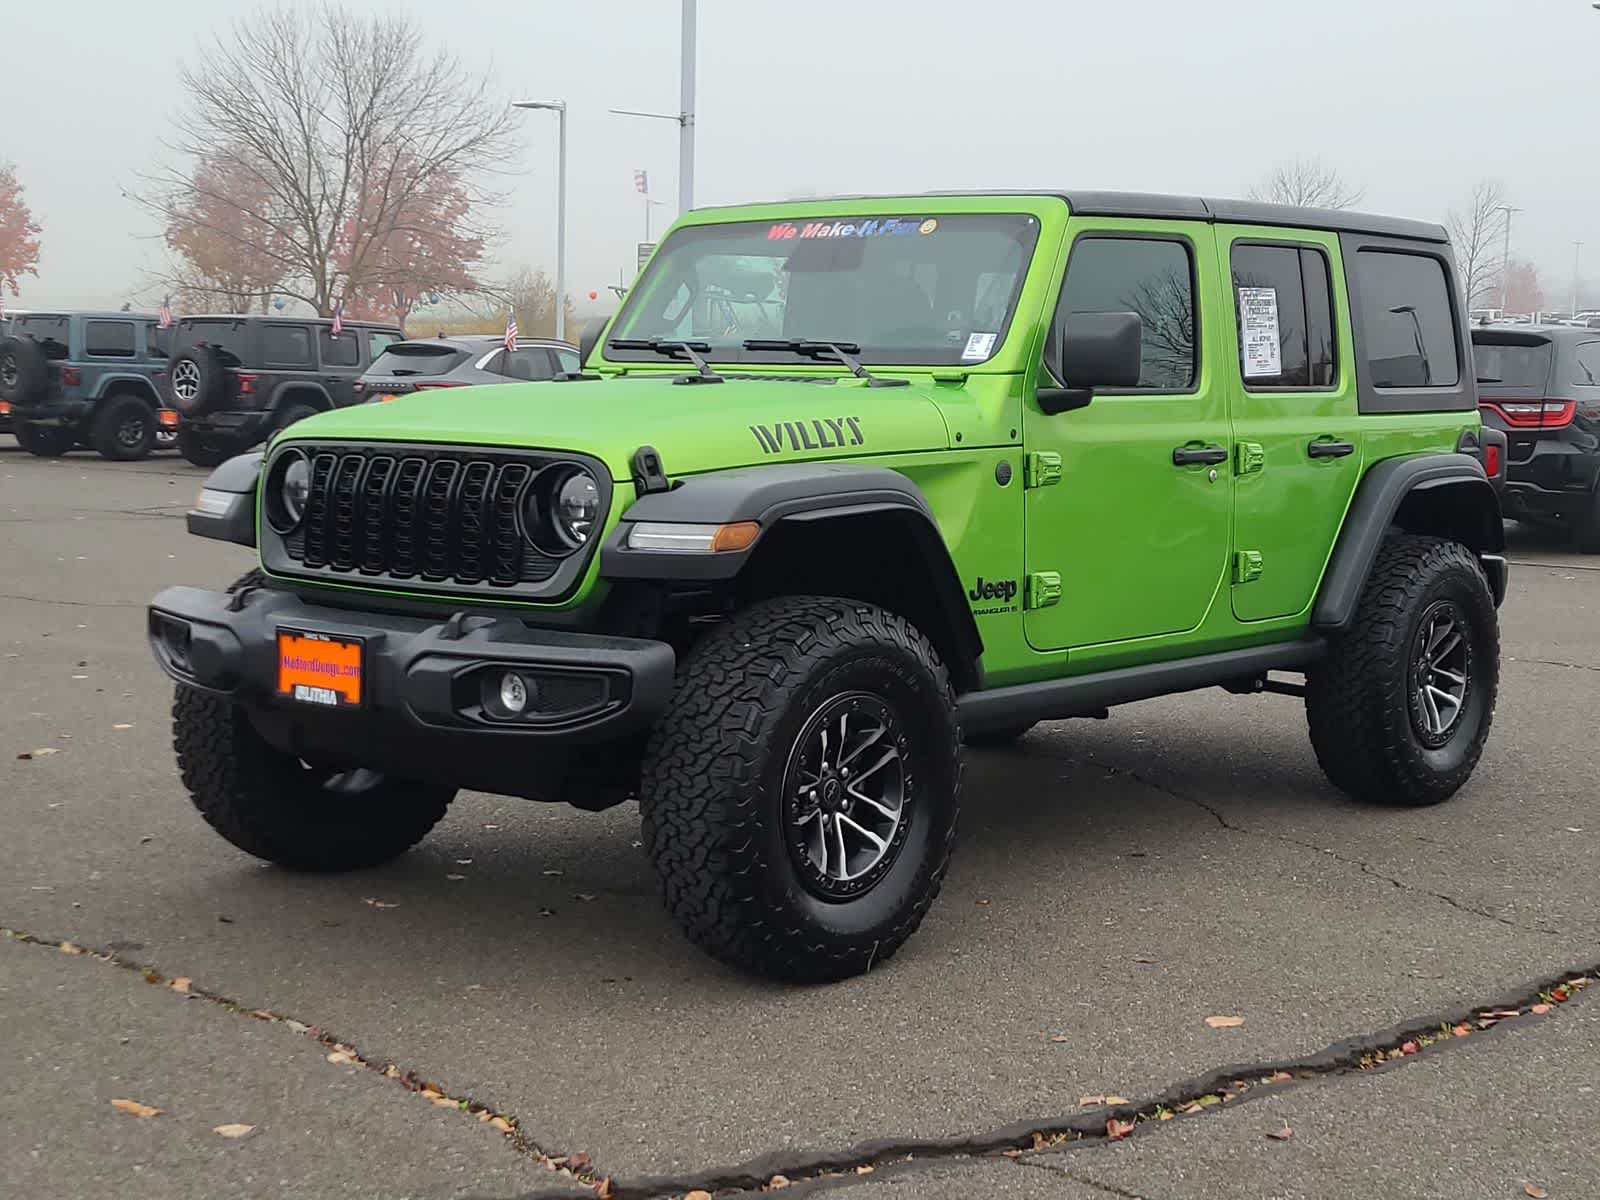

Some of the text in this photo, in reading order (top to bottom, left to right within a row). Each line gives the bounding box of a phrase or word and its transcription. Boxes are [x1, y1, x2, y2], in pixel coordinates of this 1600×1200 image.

[768, 218, 920, 240] We Make It Fun
[749, 416, 864, 454] WILLYS
[969, 576, 1017, 602] Jeep
[973, 607, 1010, 615] RANGLER
